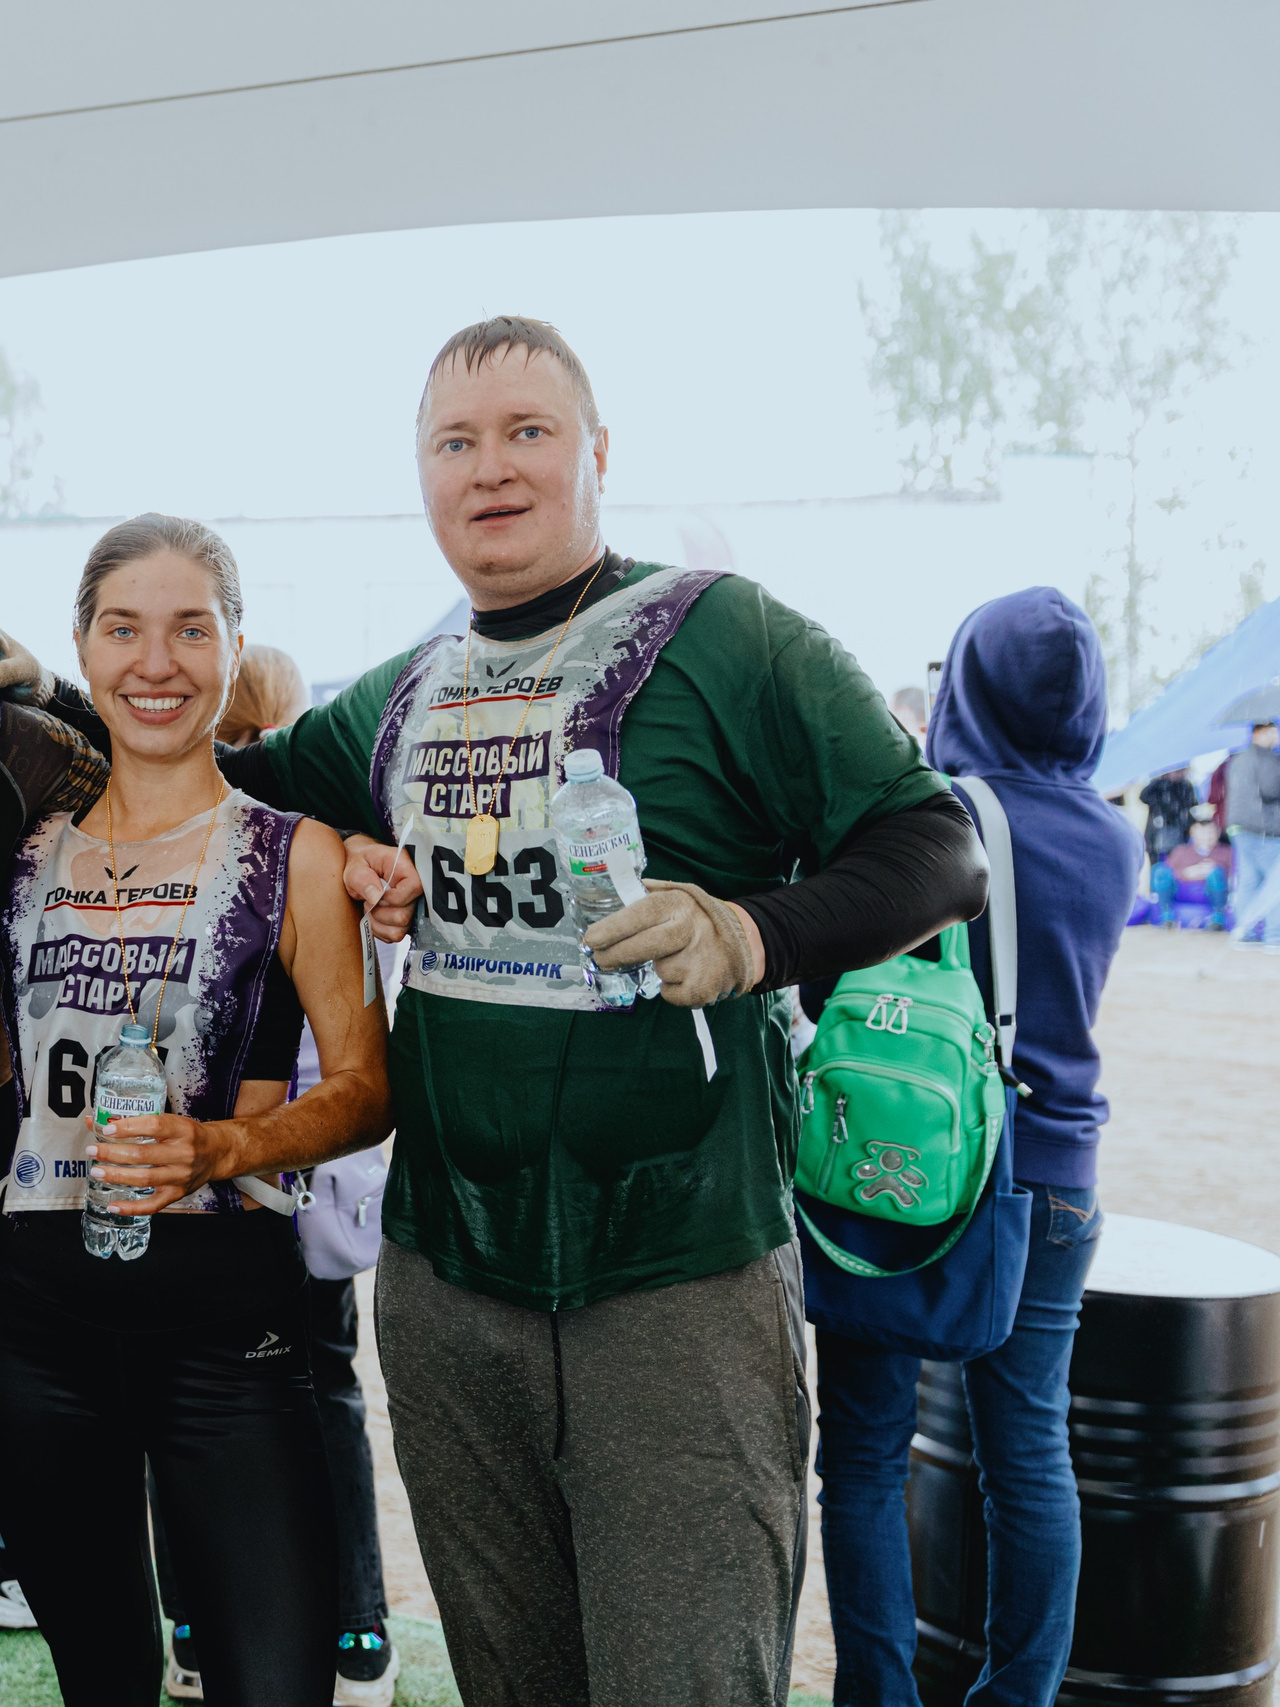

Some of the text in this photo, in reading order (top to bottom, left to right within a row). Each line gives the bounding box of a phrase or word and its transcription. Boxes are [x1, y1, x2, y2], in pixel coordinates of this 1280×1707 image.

[430, 686, 480, 704] ГОНКА
[407, 731, 545, 777] МАССОВЫЙ
[429, 783, 507, 815] СТАРТ
[569, 833, 631, 857] СЕНЕЖСКАЯ
[45, 883, 198, 905] ГОНКА ГЕРОЕВ
[405, 845, 565, 928] 663
[34, 938, 189, 977] МАССОВЫЙ
[443, 953, 562, 979] ГАЗПРОМБАНК
[58, 974, 140, 1011] СТАРТ
[100, 1095, 155, 1112] СЕНЕЖСКАЯ
[54, 1160, 88, 1178] ГАЗП
[245, 1345, 292, 1358] DEMIX
